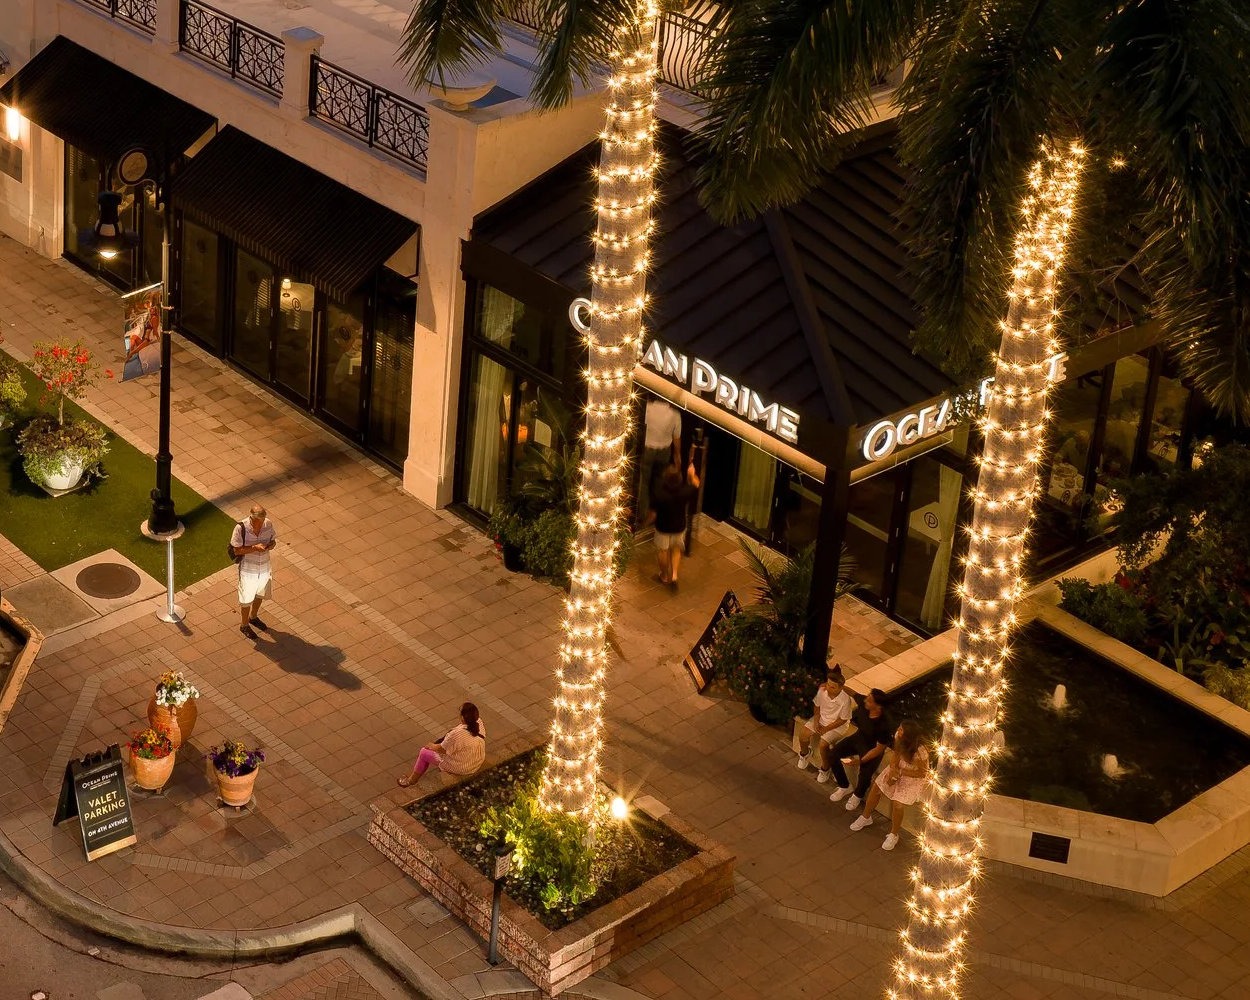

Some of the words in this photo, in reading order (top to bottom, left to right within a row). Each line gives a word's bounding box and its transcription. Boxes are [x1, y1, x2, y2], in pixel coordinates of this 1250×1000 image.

[569, 297, 688, 384] OAN
[691, 356, 801, 445] PRIME
[863, 393, 977, 462] OCEA
[82, 778, 101, 789] OCEAN
[101, 771, 118, 781] PRIME
[88, 791, 117, 808] VALET
[84, 799, 126, 821] PARKING
[108, 817, 128, 829] AVENUE
